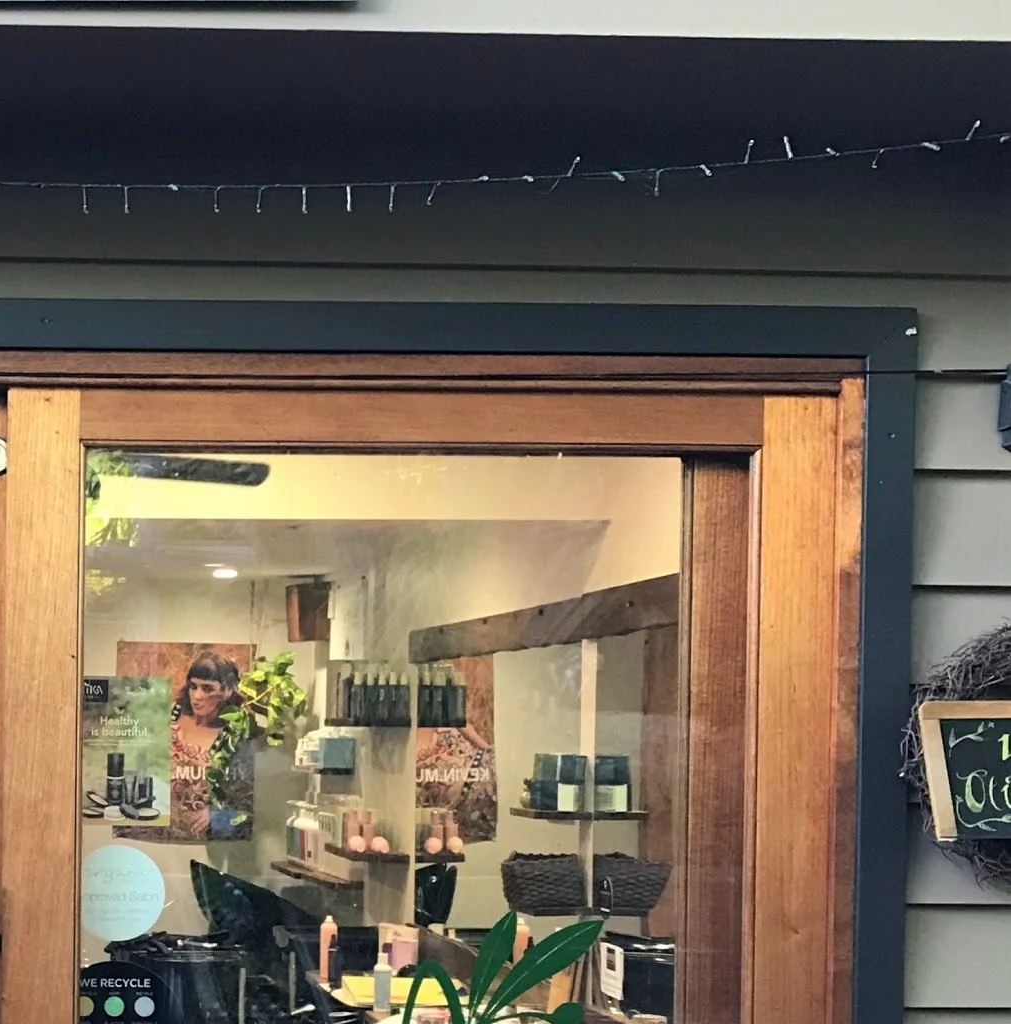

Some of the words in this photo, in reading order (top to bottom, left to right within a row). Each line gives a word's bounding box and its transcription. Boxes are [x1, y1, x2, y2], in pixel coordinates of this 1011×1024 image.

[100, 715, 139, 729] Healthy
[91, 728, 99, 736] is
[102, 727, 148, 736] beautiful
[100, 978, 151, 988] RECYCLE
